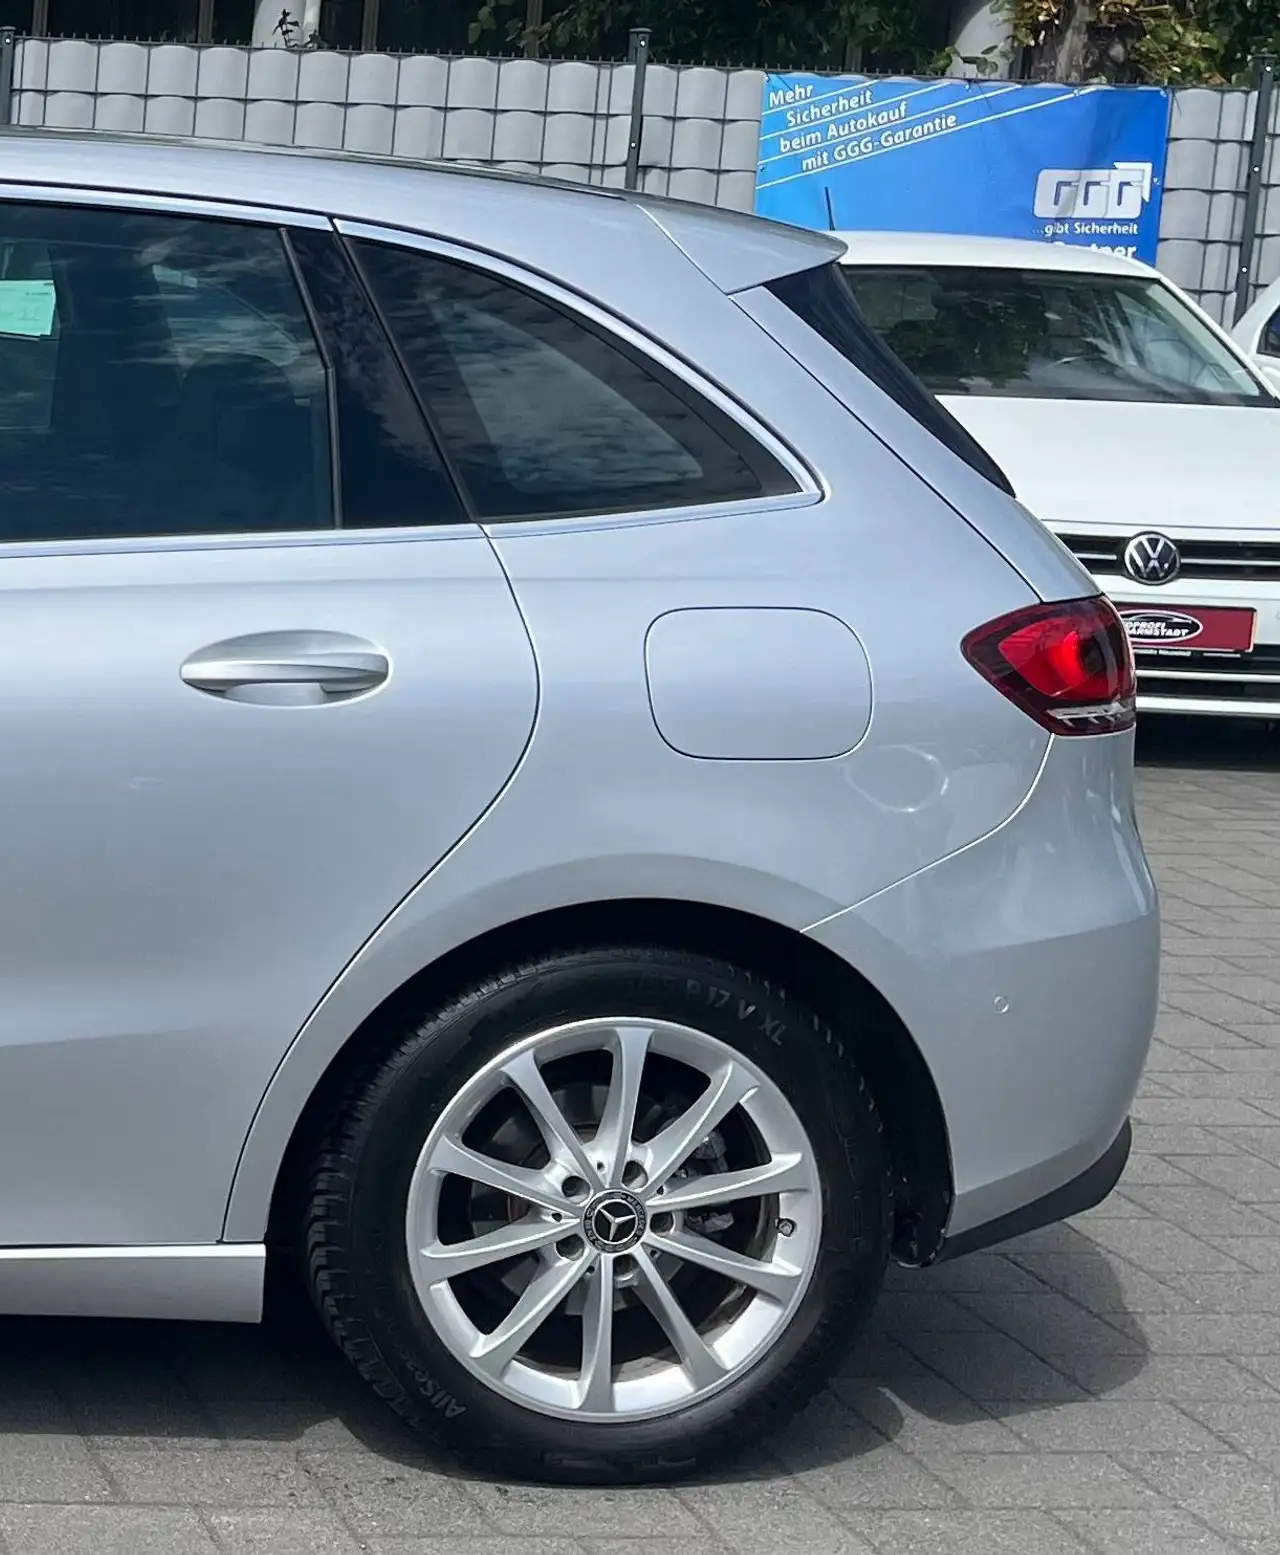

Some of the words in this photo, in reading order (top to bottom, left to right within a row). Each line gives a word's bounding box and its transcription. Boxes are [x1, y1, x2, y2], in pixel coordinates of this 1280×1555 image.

[769, 84, 814, 108] Mehr
[787, 90, 873, 127] Sicherheit
[779, 132, 821, 153] beim
[827, 101, 908, 140] Autokauf
[802, 150, 828, 172] mit
[834, 114, 957, 162] GGG-Garantie
[1074, 222, 1138, 235] Sicherheit
[1128, 627, 1189, 637] ARMSTADT
